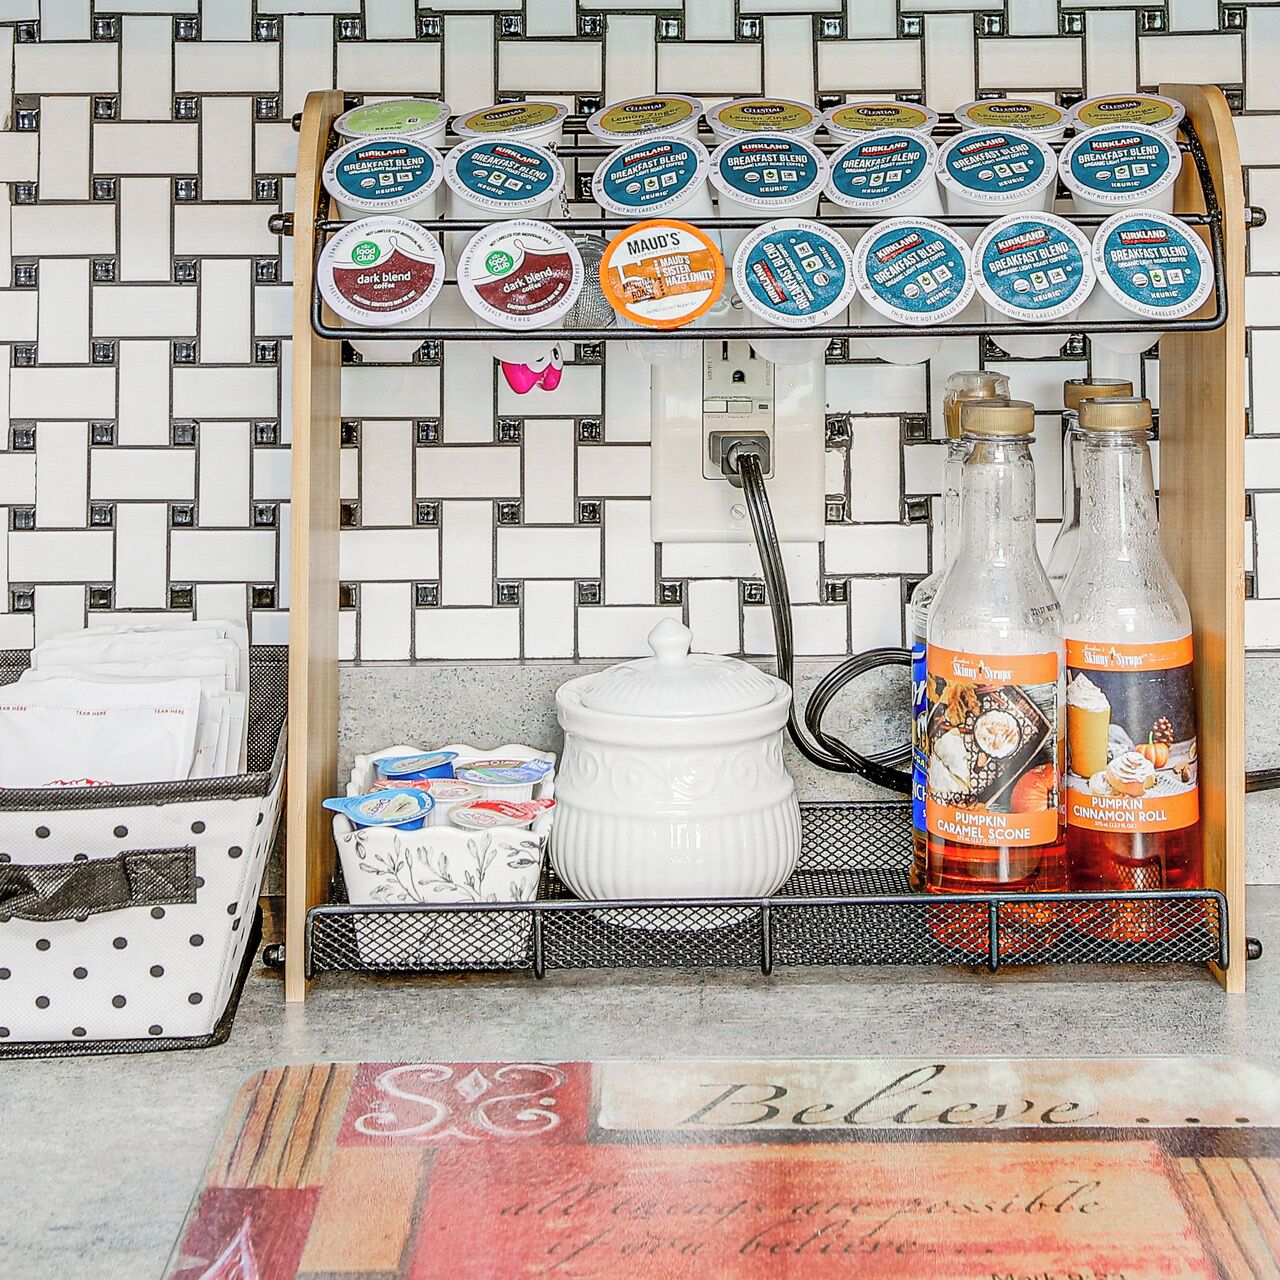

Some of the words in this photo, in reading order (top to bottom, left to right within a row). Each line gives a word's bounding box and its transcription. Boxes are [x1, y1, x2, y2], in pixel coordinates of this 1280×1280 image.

[611, 114, 644, 122] Lemon
[862, 142, 908, 153] KIRKLAND
[960, 137, 1005, 153] KIRKLAND
[1091, 137, 1141, 149] KIRKLAND
[358, 148, 407, 159] KIRKLAND
[495, 146, 541, 165] KIRKLAND
[624, 145, 671, 163] KIRKLAND
[727, 154, 777, 166] BREAKFAST
[779, 154, 808, 163] BLEND
[842, 156, 891, 169] BREAKFAST
[891, 151, 920, 162] BLEND
[952, 150, 1001, 169] BREAKFAST
[1000, 143, 1030, 157] BLEND
[1077, 149, 1128, 164] BREAKFAST
[1130, 145, 1160, 156] BLEND
[343, 159, 394, 172] BREAKFAST
[395, 156, 425, 166] BLEND
[470, 151, 520, 171] BREAKFAST
[519, 165, 547, 181] BLEND
[610, 160, 660, 181] BREAKFAST
[659, 151, 688, 165] BLEND
[997, 229, 1046, 250] KIRKLAND
[1120, 229, 1167, 240] KIRKLAND
[356, 246, 376, 255] food
[626, 232, 680, 256] MAUD'S
[875, 233, 919, 259] KIRKLAND
[356, 253, 376, 261] club
[489, 254, 508, 267] food
[660, 255, 691, 267] MAUD'S
[762, 242, 787, 269] BLEND
[872, 252, 921, 284] BREAKFAST
[916, 239, 946, 259] BLEND
[988, 251, 1038, 273] BREAKFAST
[1039, 241, 1070, 257] BLEND
[1109, 248, 1158, 263] BREAKFAST
[1160, 245, 1188, 257] BLEND
[492, 262, 511, 273] club
[662, 264, 691, 277] SISTER
[357, 272, 380, 285] dark
[382, 271, 412, 282] blend
[373, 282, 396, 290] coffee
[502, 278, 526, 294] dark
[524, 266, 554, 285] blend
[753, 263, 782, 304] KIRKLAND
[521, 282, 543, 294] coffee
[779, 268, 811, 311] BREAKFAST
[890, 310, 904, 319] THIS
[1084, 651, 1110, 668] Skinny
[1115, 653, 1143, 668] Syrups
[952, 661, 977, 680] Skinny
[984, 666, 1013, 682] Syrups
[1091, 796, 1144, 810] PUMPKIN
[955, 811, 1007, 828] PUMPKIN
[1073, 804, 1136, 822] CINNAMON
[1138, 809, 1168, 822] ROLL
[936, 819, 985, 839] CARAMEL
[988, 827, 1031, 840] SCONE
[680, 1063, 1099, 1127] Believe
[867, 1179, 1105, 1237] possible
